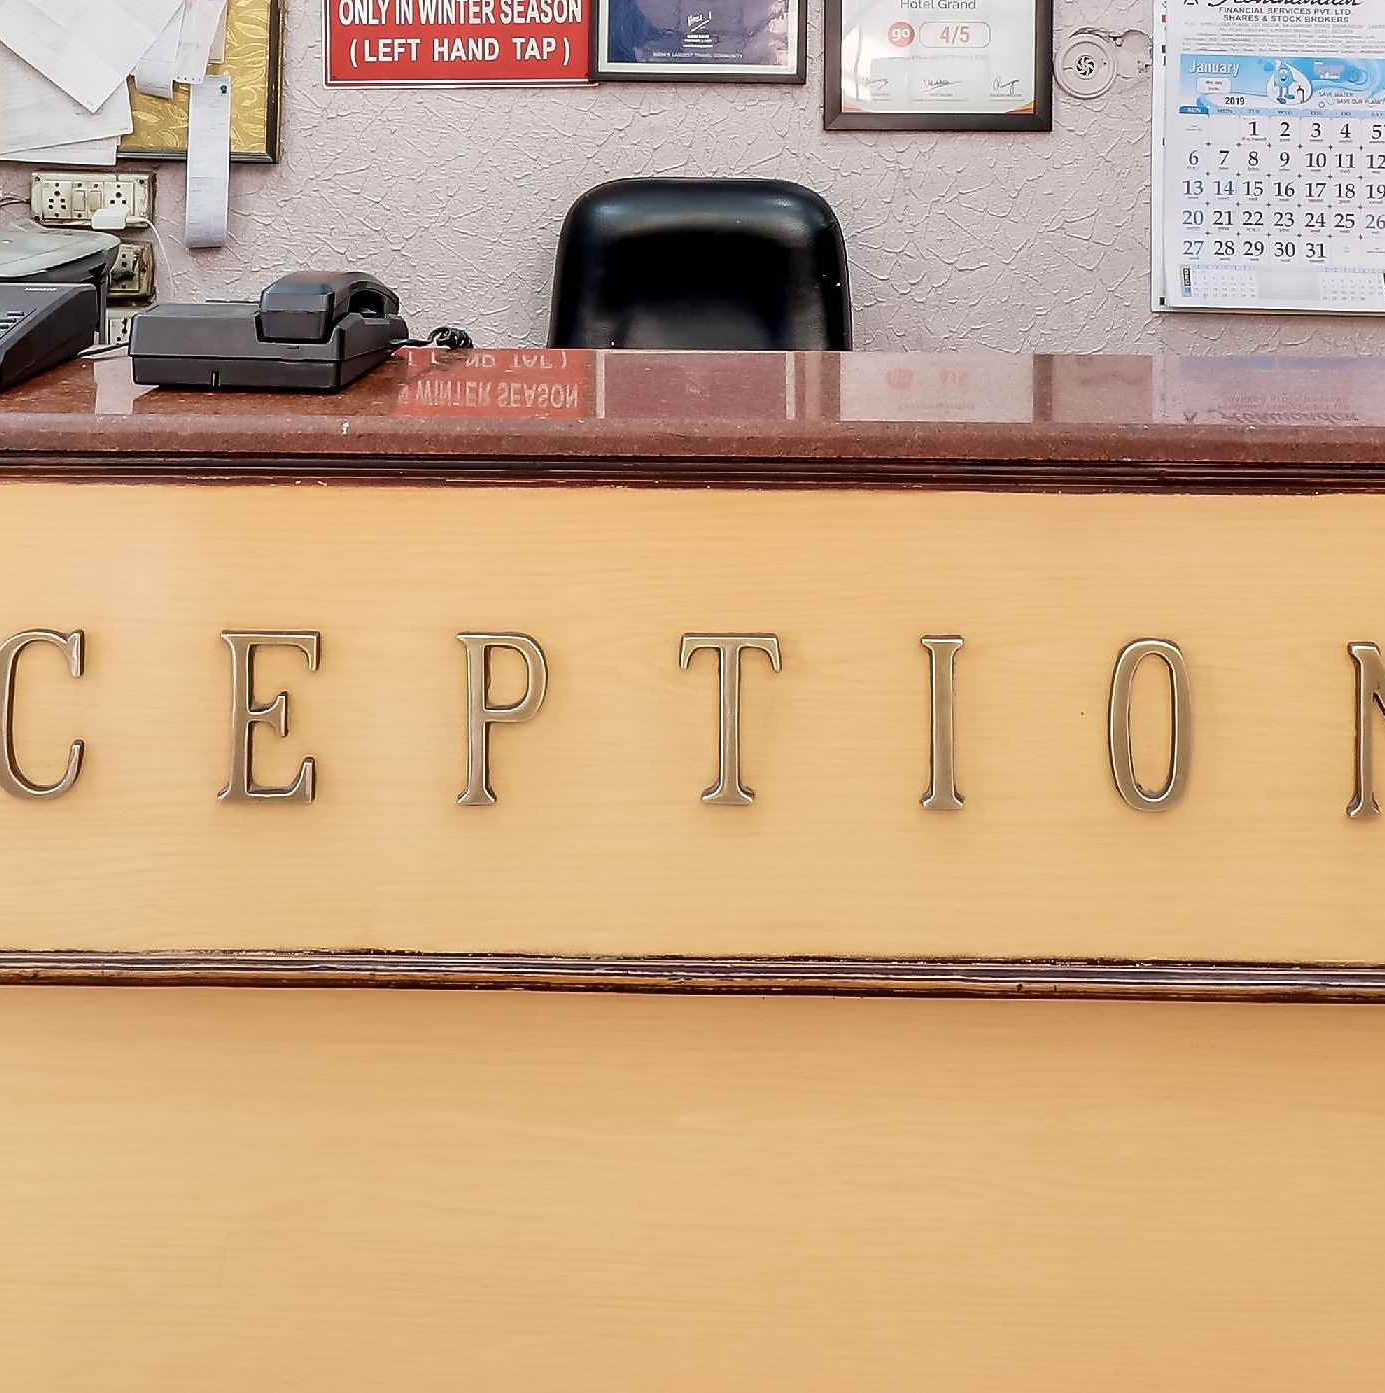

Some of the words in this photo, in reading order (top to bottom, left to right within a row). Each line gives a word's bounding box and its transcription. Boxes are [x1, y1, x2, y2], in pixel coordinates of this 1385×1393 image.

[900, 0, 935, 9] Hotel
[938, 0, 976, 9] Grand
[1267, 7, 1312, 15] SERVICES
[891, 28, 910, 42] go
[939, 26, 970, 44] 4/5
[433, 38, 499, 62] HAND
[1189, 60, 1240, 76] January
[1225, 97, 1245, 106] 2019
[1248, 121, 1260, 136] 1
[1280, 122, 1291, 136] 2
[1311, 122, 1321, 138] 3
[1339, 123, 1352, 138] 4
[1372, 124, 1382, 140] 5
[1189, 150, 1199, 165] 6
[1219, 151, 1229, 165] 7
[1248, 152, 1258, 166] 8
[1280, 152, 1290, 167] 9
[1305, 153, 1327, 168] 10
[1336, 153, 1355, 169] 11
